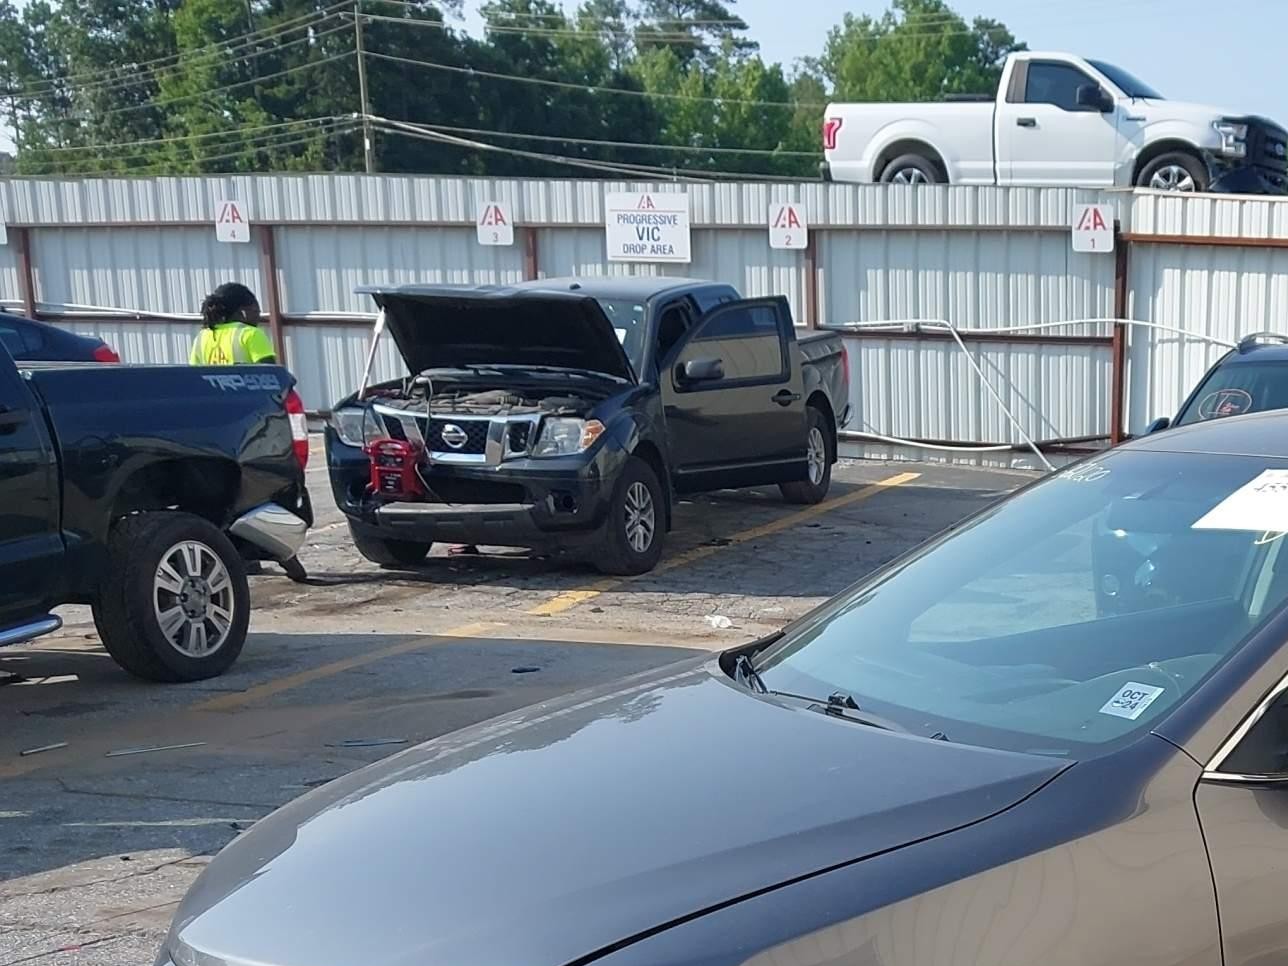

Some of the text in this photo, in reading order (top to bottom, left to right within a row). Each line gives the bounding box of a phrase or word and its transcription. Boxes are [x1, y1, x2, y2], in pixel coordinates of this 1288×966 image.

[616, 213, 679, 225] PROGRESSIVE
[492, 231, 499, 242] 3
[635, 226, 661, 242] VIC
[784, 235, 792, 246] 2
[1089, 238, 1096, 249] 1
[622, 243, 675, 256] DROP AREA
[1121, 689, 1149, 701] OCT
